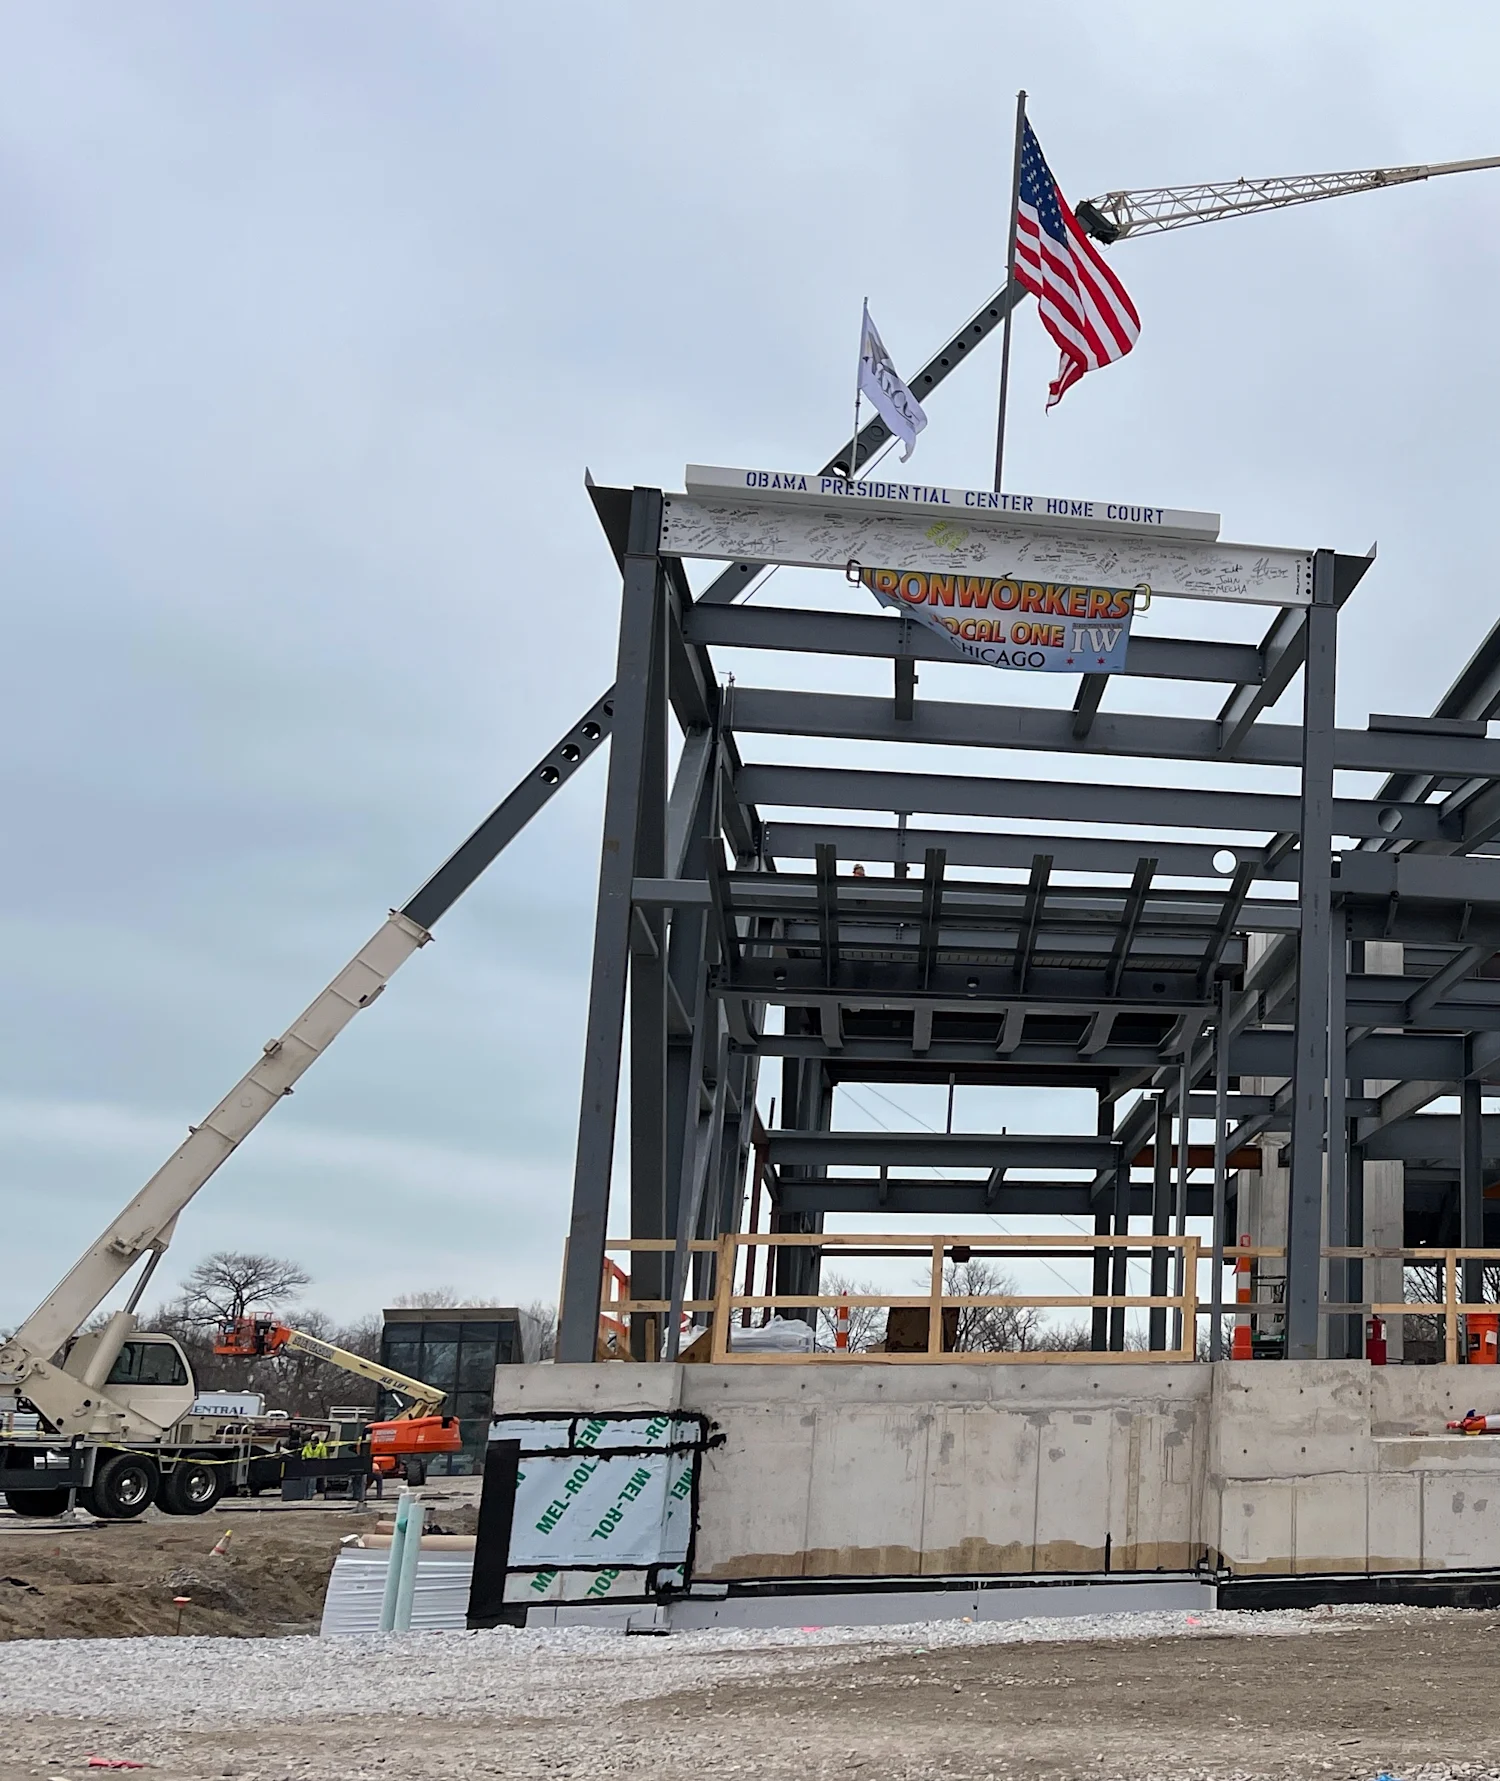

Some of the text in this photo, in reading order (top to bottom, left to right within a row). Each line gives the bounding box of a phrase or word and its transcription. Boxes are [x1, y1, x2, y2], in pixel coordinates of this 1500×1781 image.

[746, 472, 1164, 524] OBAMA PRESIDENTIAL CENTER HOME COURT
[863, 568, 1132, 619] IRONWORKERS
[940, 616, 1065, 648] OCAL ONE
[950, 636, 1045, 668] CHICAGO
[1070, 628, 1123, 653] IW
[195, 1405, 248, 1416] ENTRAL
[535, 1458, 599, 1535] MEL-ROL
[590, 1467, 652, 1540] MEL-ROL
